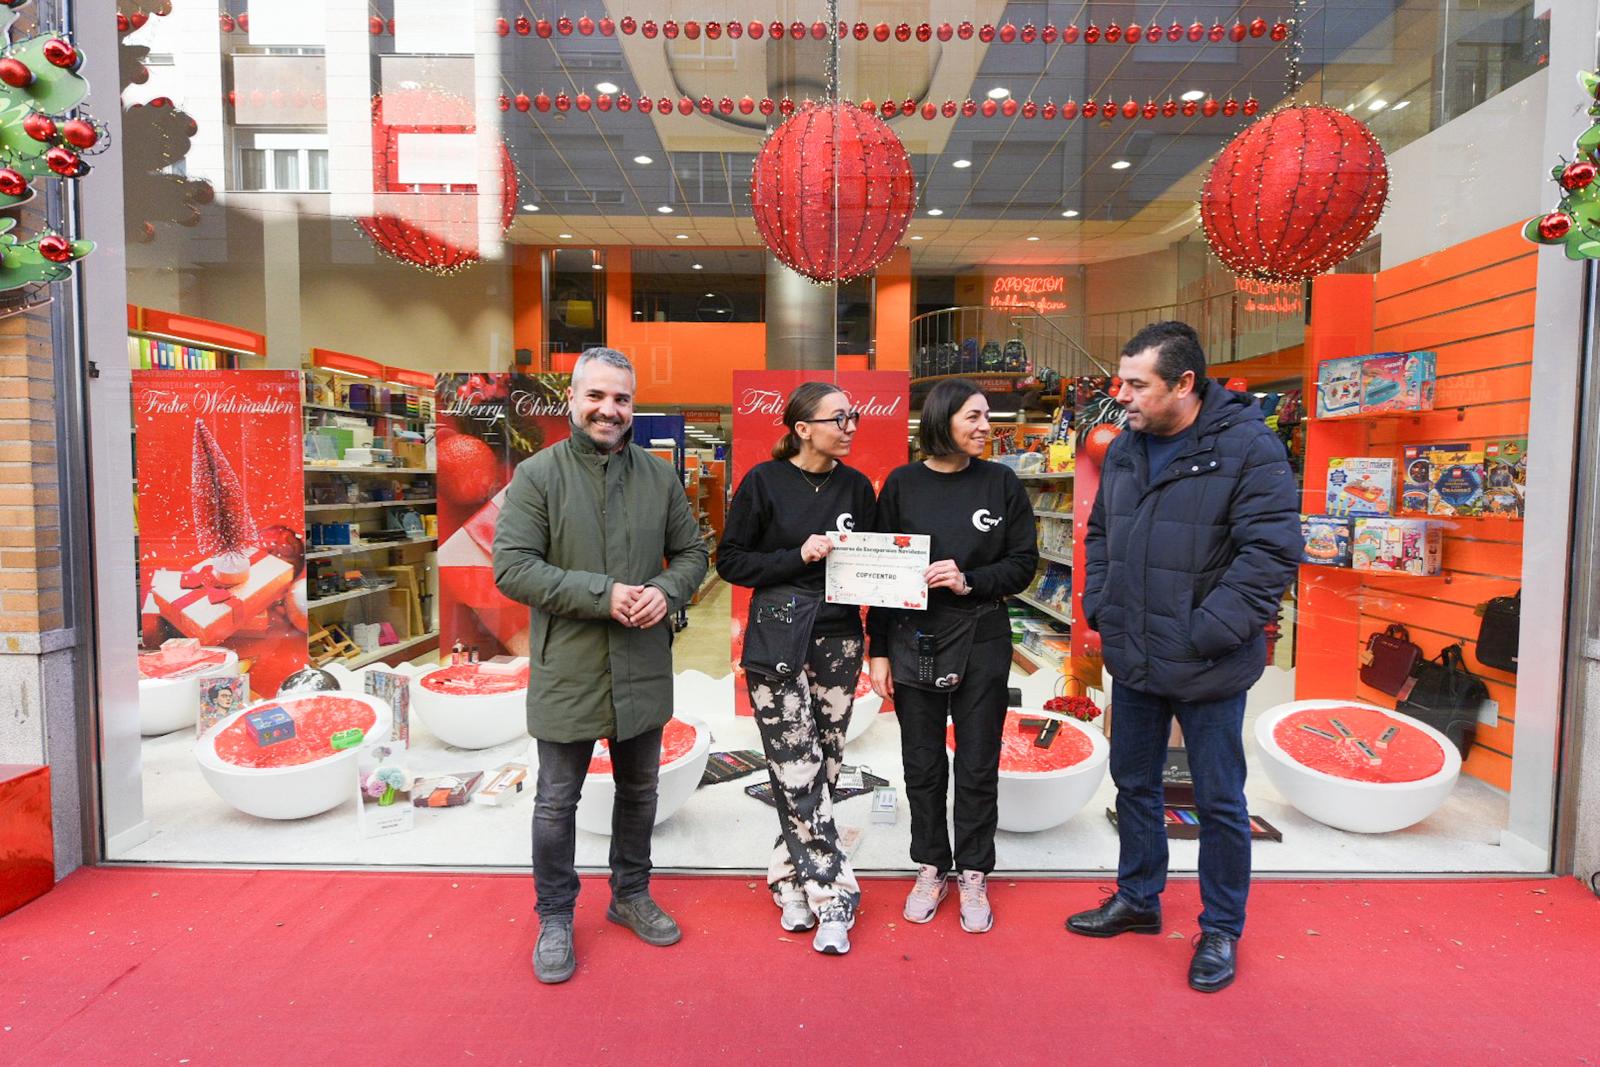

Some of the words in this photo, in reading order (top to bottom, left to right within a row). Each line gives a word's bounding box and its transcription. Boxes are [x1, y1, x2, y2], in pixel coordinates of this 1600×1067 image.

[141, 388, 189, 414] Frohe
[194, 385, 295, 414] Weihnachten
[443, 391, 502, 427] Merry
[510, 390, 571, 417] Christ
[855, 571, 897, 580] COPYCENTRO
